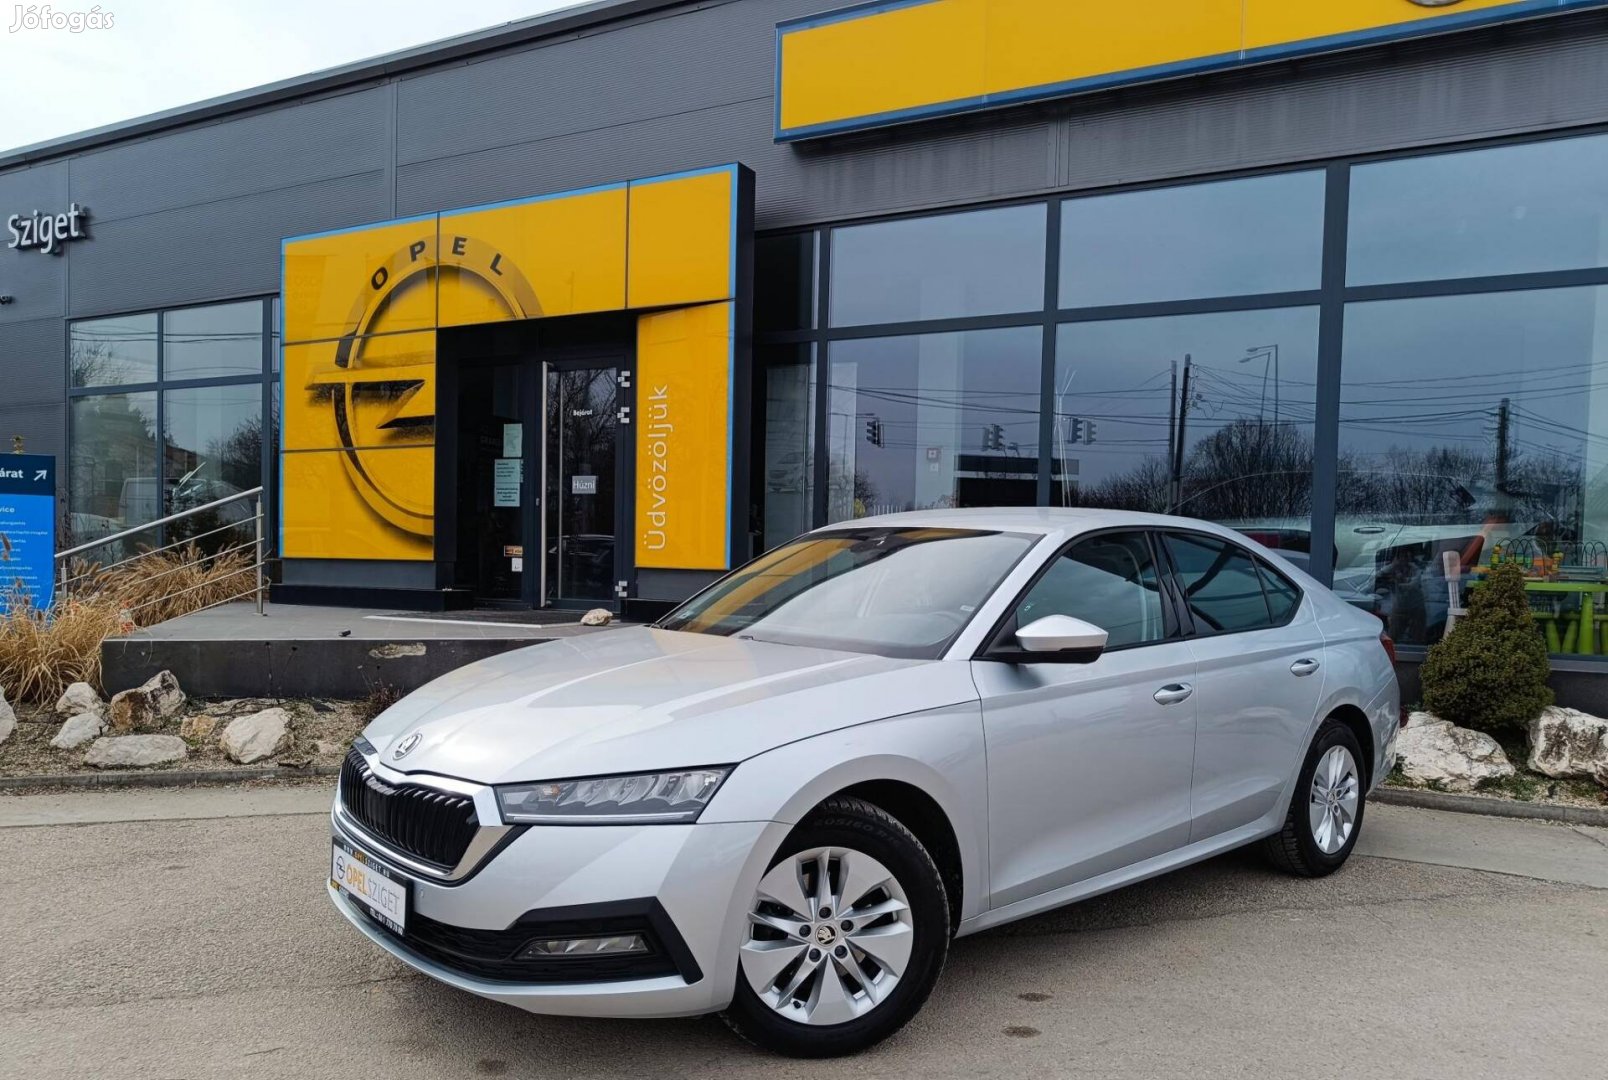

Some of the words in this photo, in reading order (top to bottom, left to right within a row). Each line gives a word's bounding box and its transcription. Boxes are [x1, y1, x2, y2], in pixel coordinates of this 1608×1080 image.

[7, 202, 79, 254] Sziget
[371, 236, 504, 290] OPEL
[573, 479, 595, 489] Húzni
[644, 384, 673, 550] Üdvözöljük
